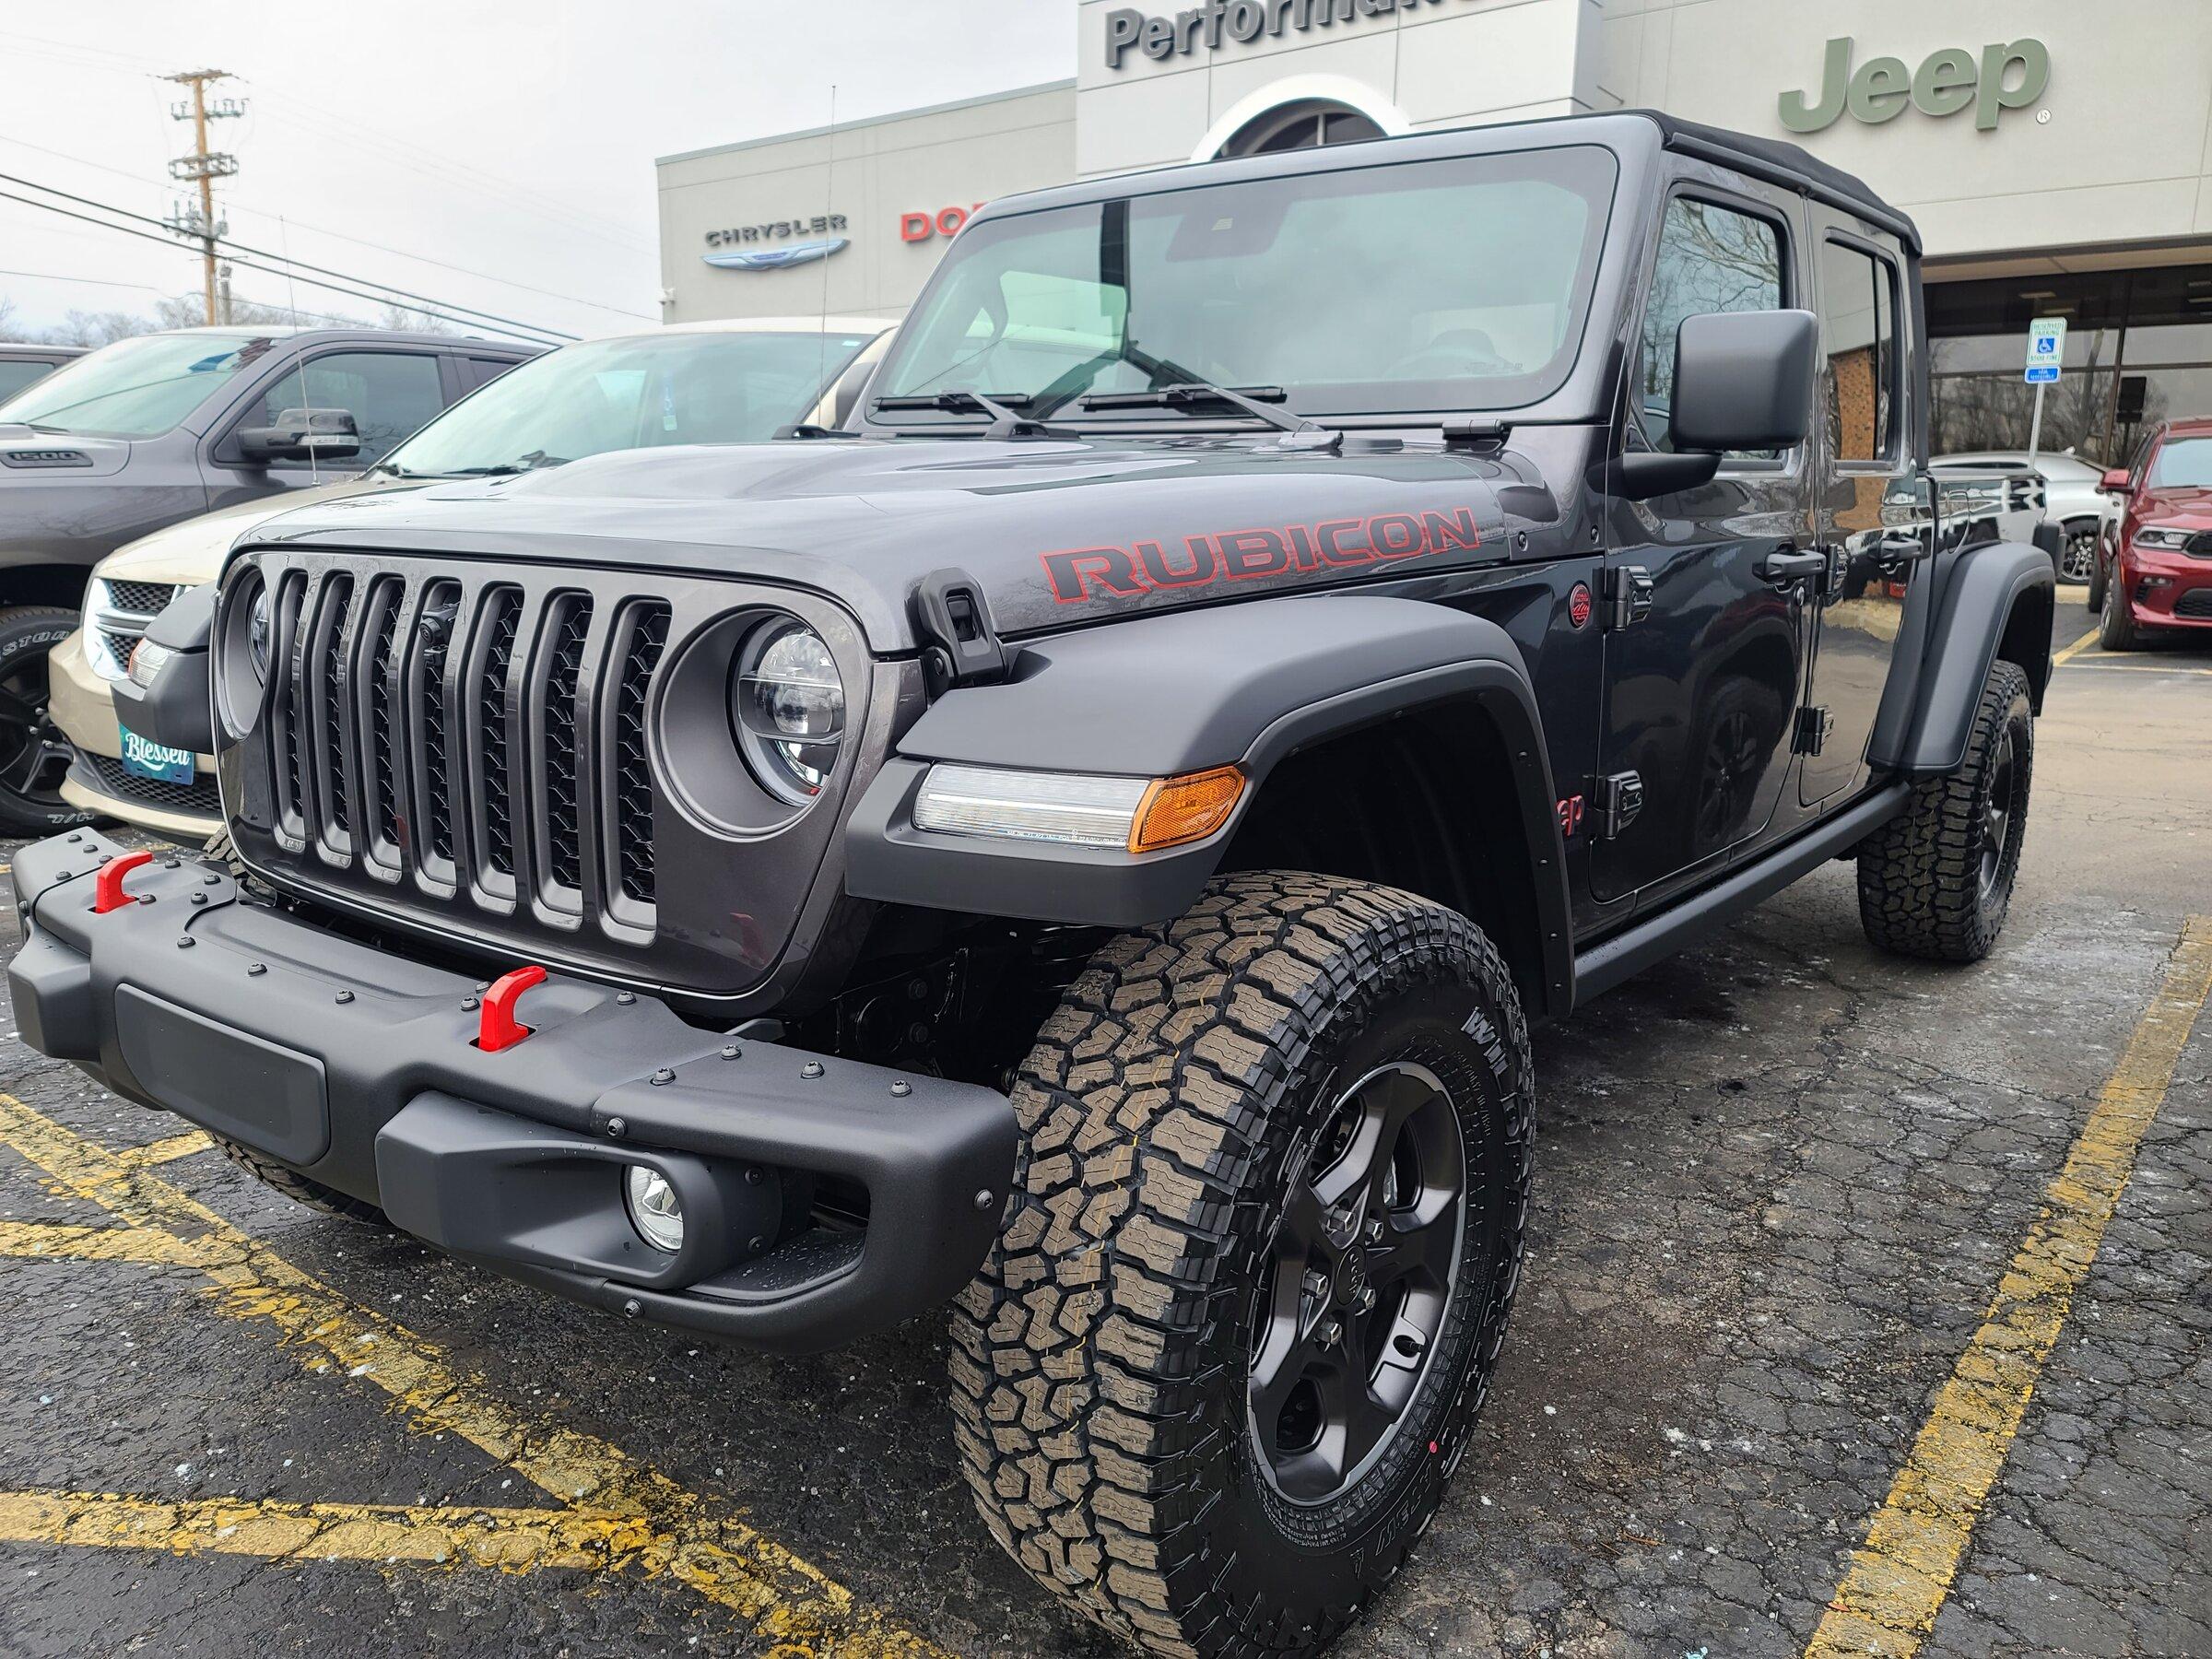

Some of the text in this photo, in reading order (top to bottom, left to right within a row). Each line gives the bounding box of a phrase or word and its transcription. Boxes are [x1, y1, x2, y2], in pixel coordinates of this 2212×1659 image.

[1778, 36, 2051, 133] Jeep
[705, 214, 848, 247] CHRYSLER
[900, 201, 989, 242] DO
[6, 451, 78, 462] 1500
[1041, 508, 1480, 604] RUBICON
